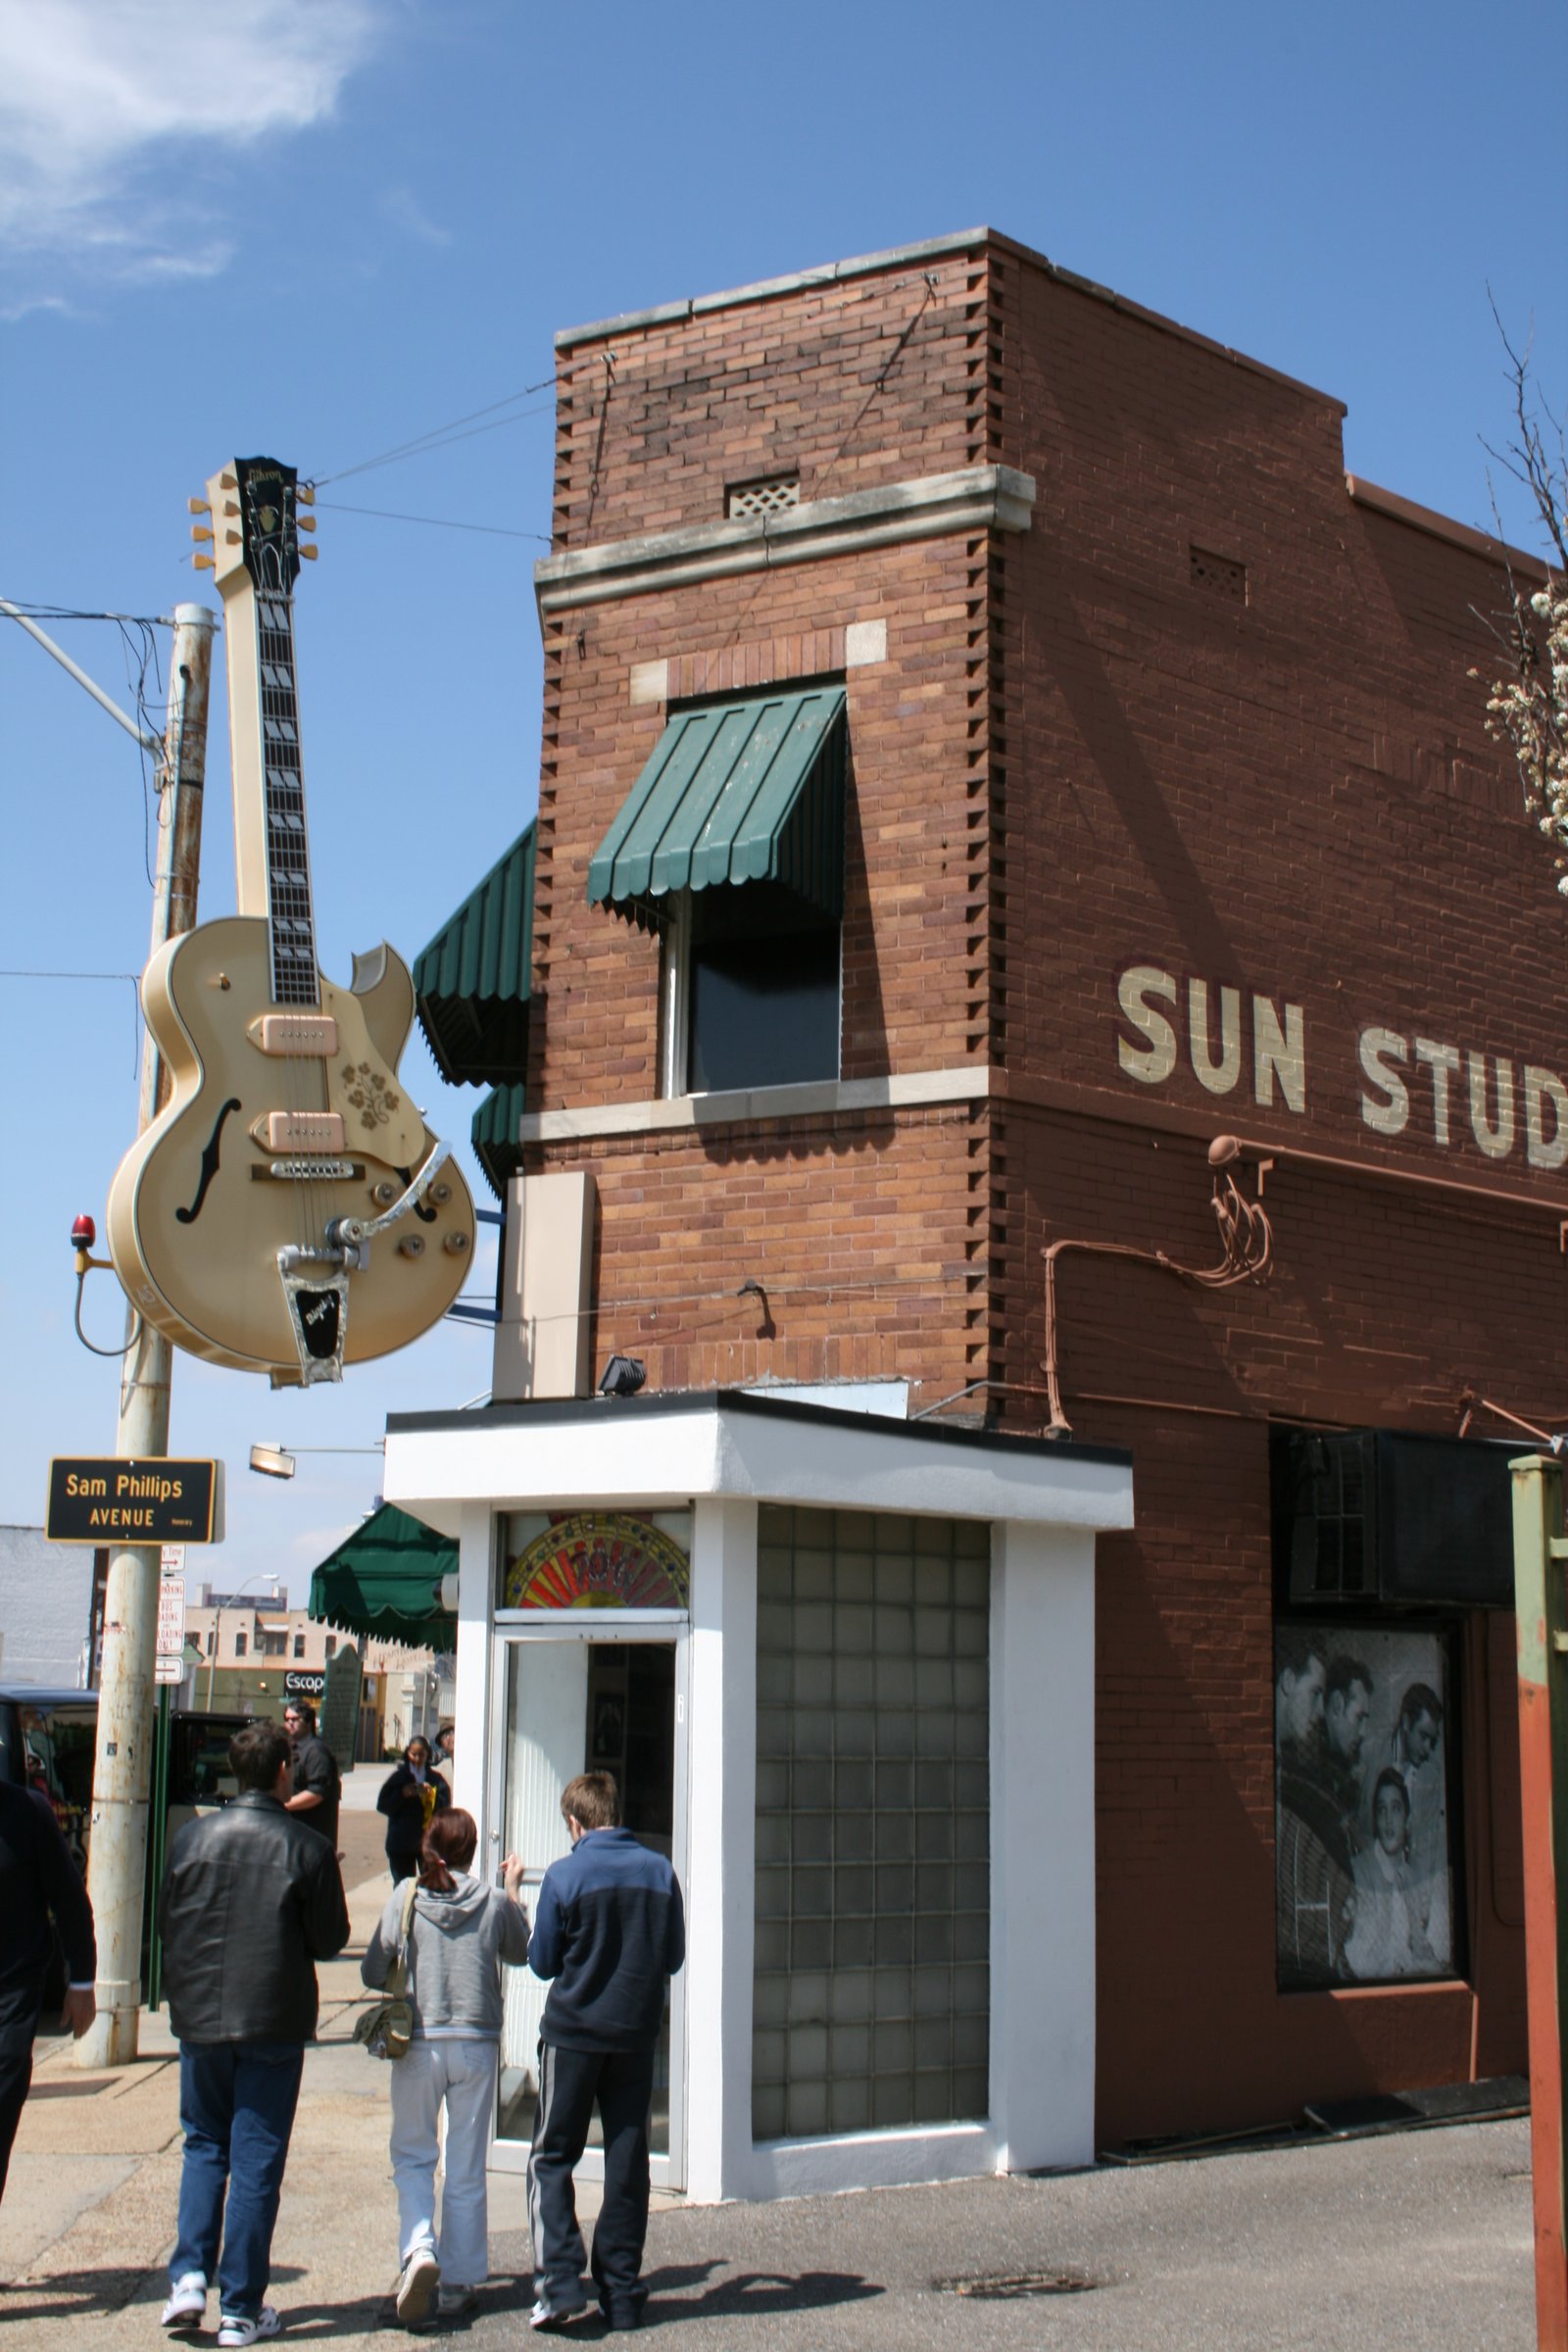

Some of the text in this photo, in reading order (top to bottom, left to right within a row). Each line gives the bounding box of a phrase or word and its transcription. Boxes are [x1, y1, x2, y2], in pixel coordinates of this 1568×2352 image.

[1118, 966, 1305, 1113] SUN
[66, 1473, 183, 1503] Sam Phillips
[90, 1508, 155, 1527] AVENUE
[285, 1672, 325, 1693] Escap
